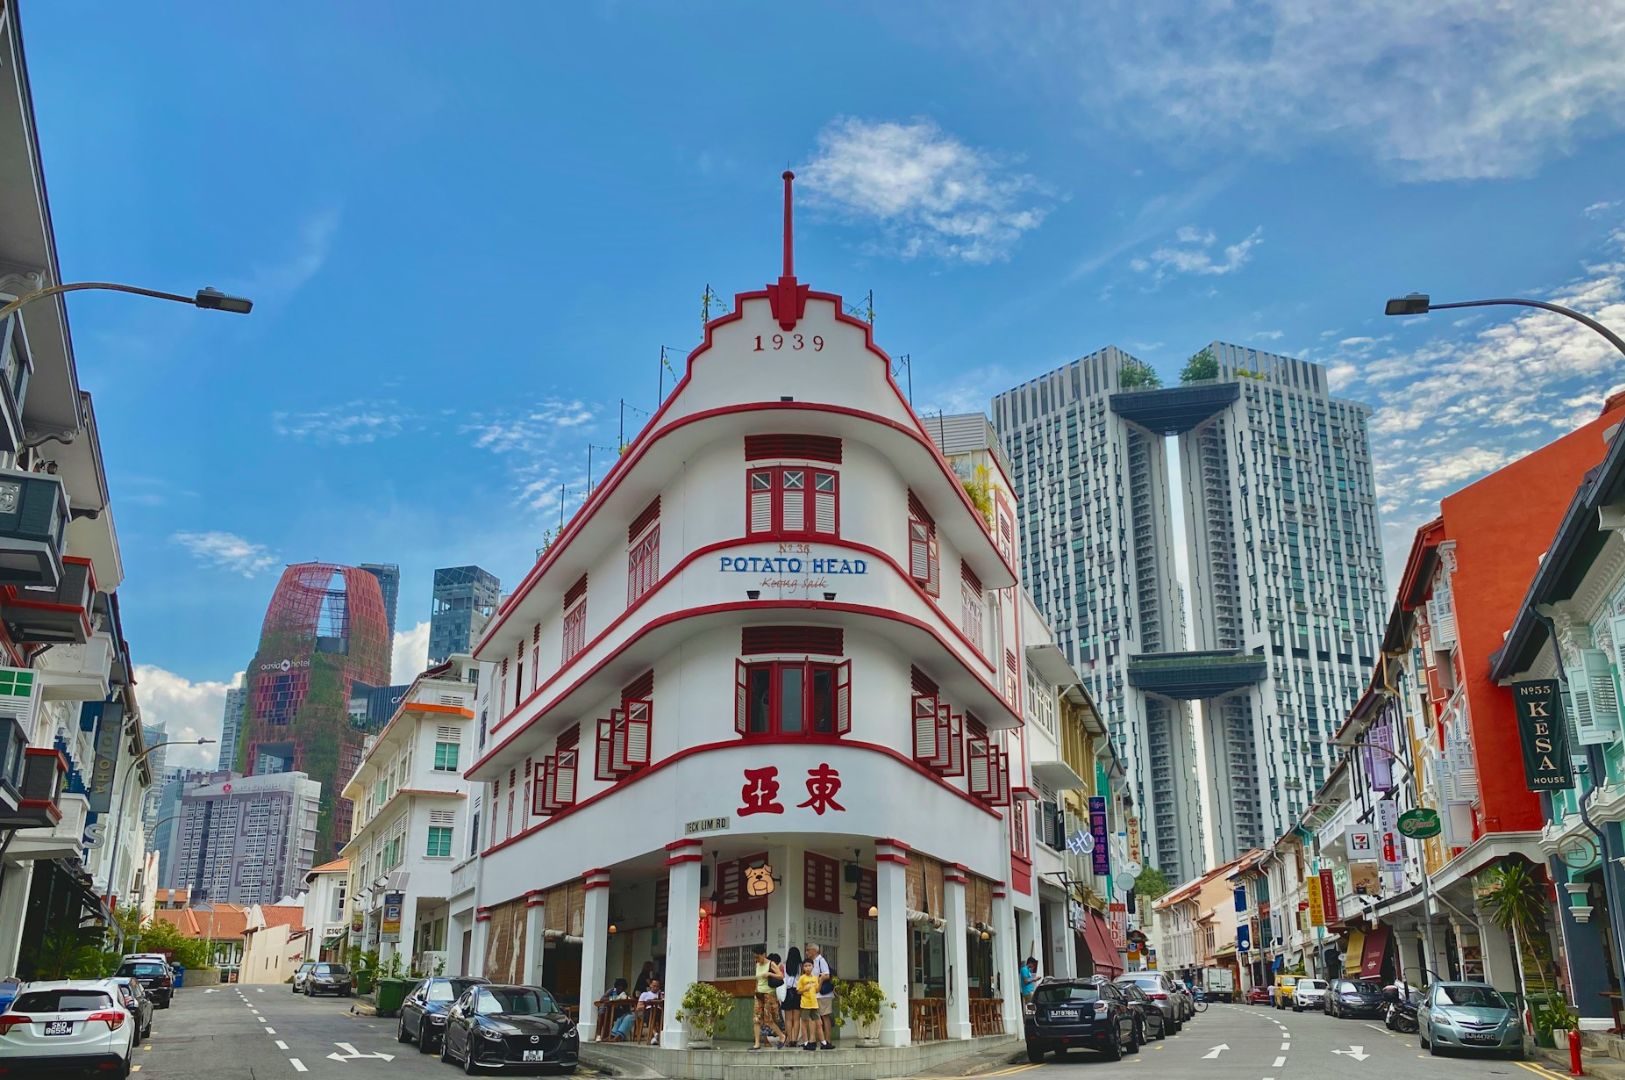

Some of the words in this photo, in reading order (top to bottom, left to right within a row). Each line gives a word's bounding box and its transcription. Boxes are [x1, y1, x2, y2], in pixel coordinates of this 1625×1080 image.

[753, 334, 824, 352] 1939
[796, 544, 811, 553] 36
[720, 557, 802, 573] POTATO
[813, 559, 867, 574] HEAD
[702, 819, 714, 830] LIM
[716, 818, 726, 828] RD
